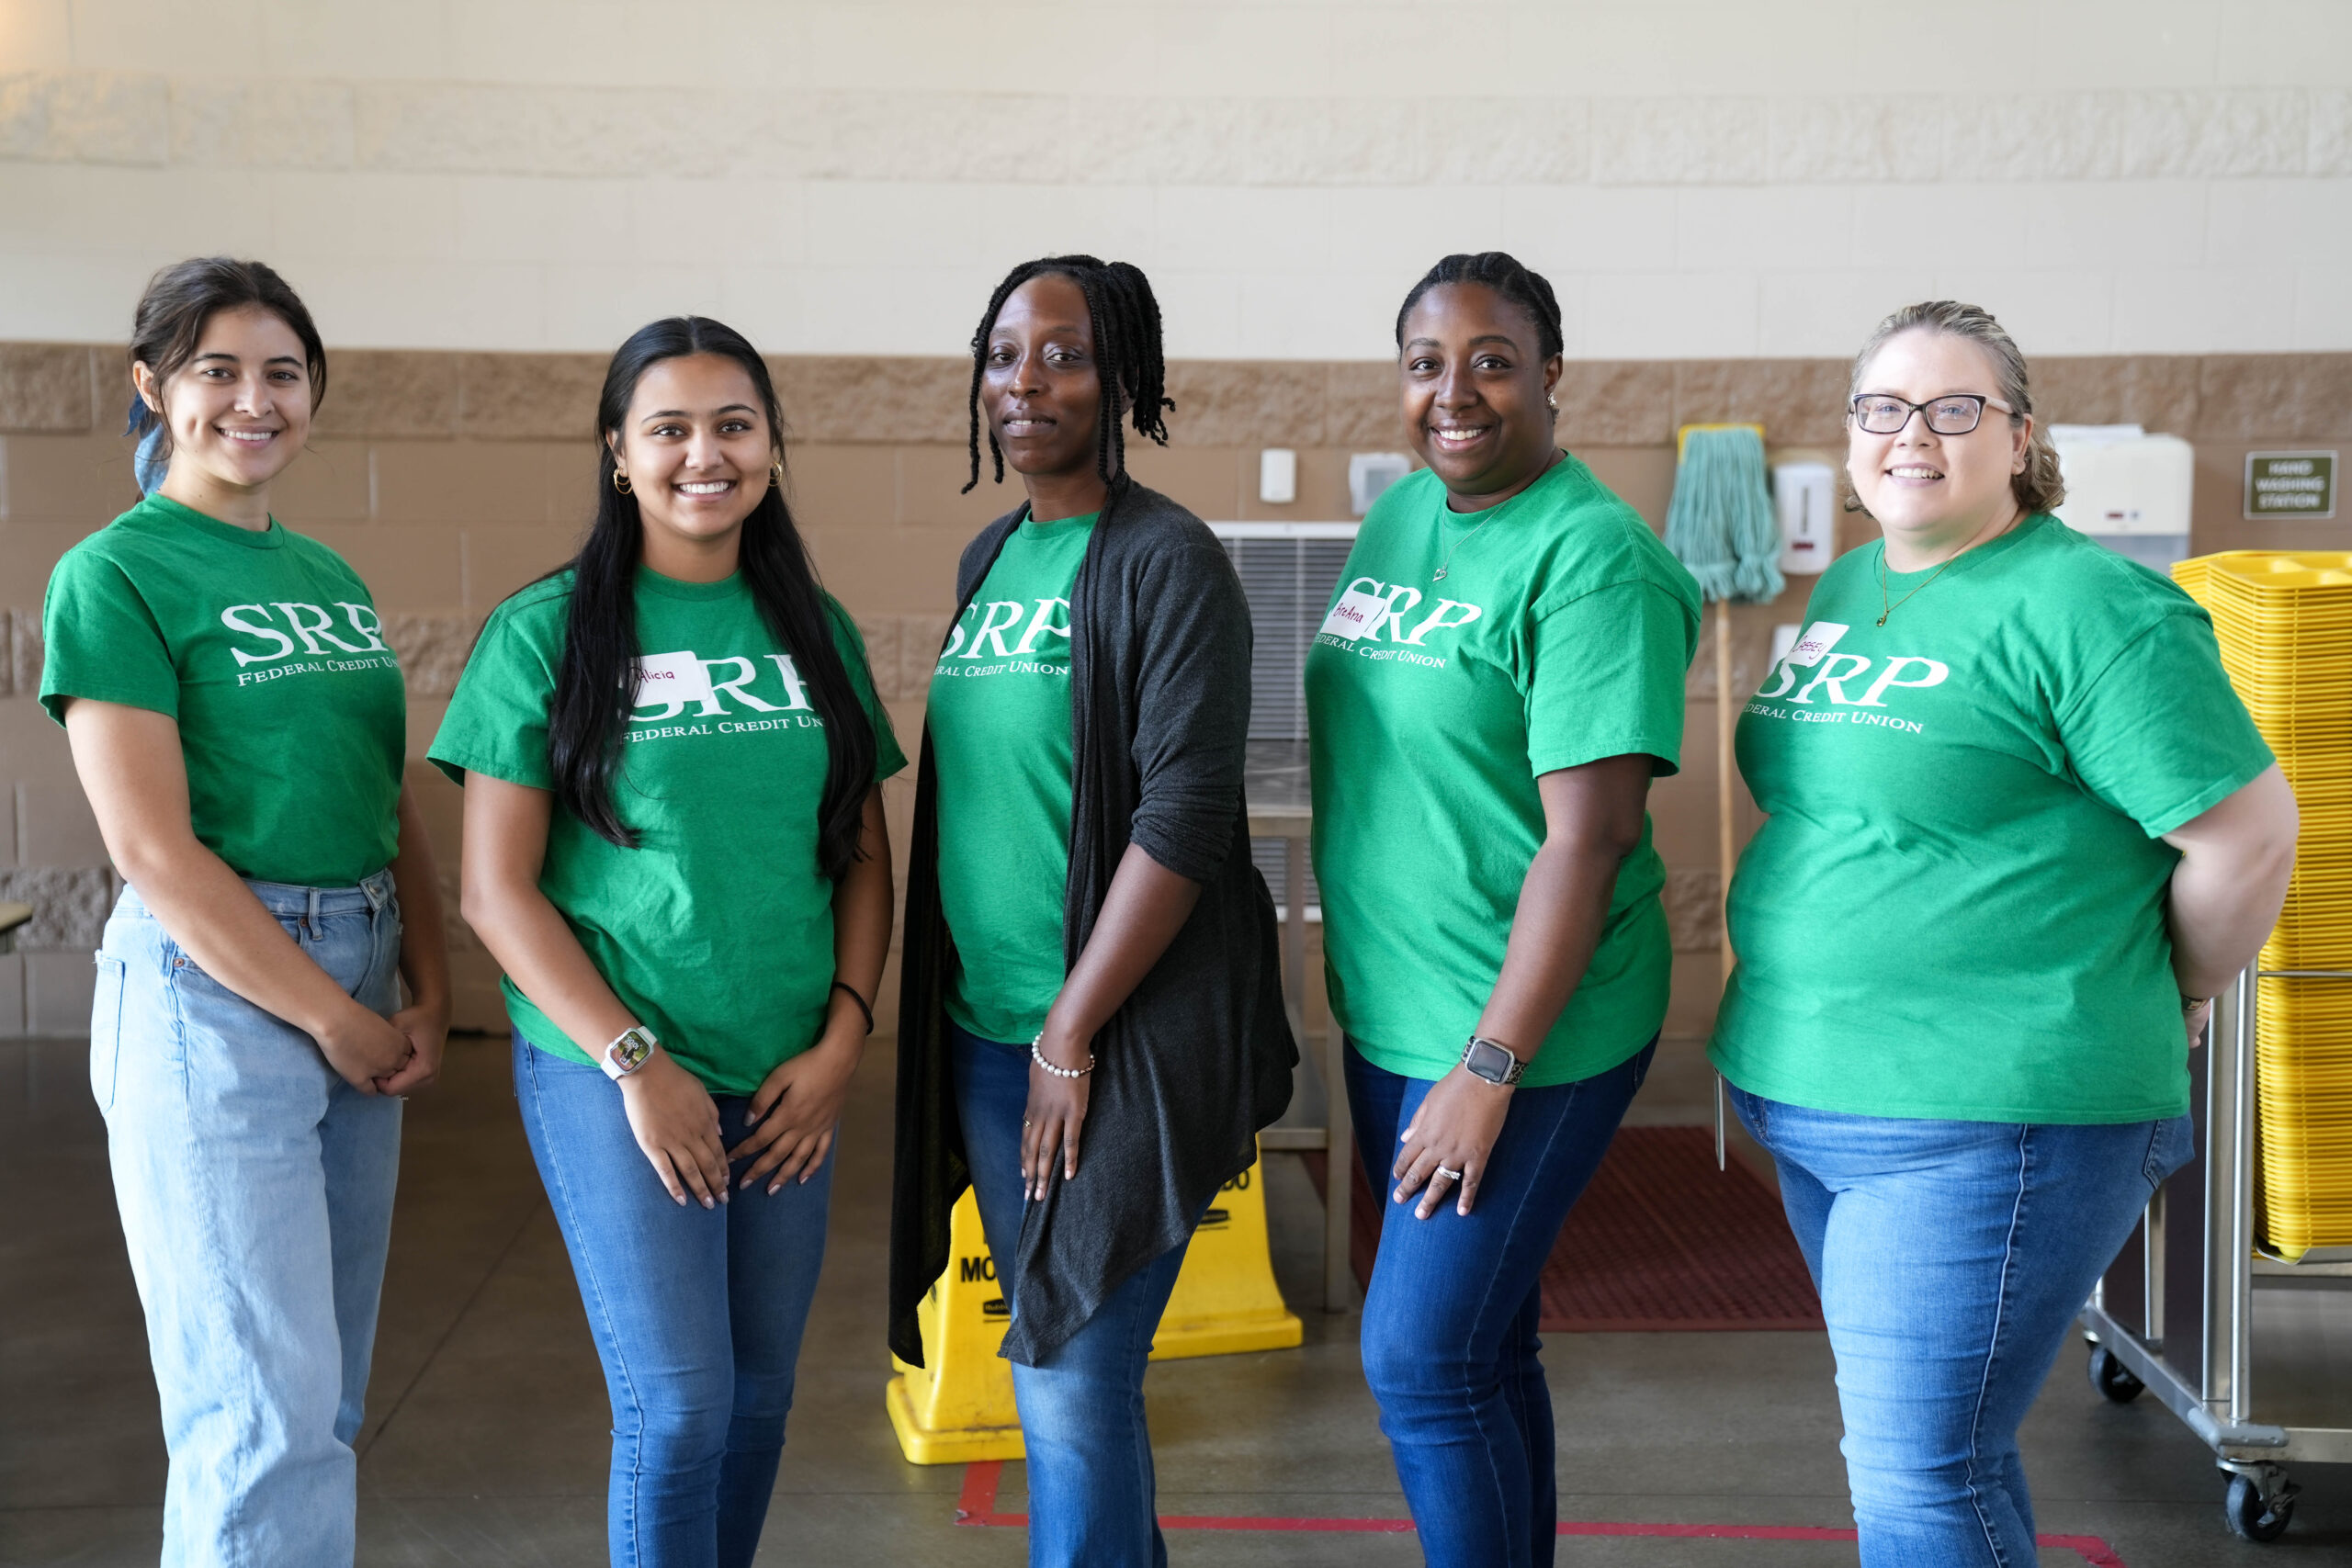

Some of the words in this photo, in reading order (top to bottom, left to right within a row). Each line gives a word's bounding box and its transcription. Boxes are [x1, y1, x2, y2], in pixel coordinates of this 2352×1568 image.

[220, 602, 389, 668] SRP
[965, 664, 1007, 678] CREDIT
[1009, 660, 1069, 675] UNION
[1397, 649, 1448, 669] UNION
[237, 662, 324, 687] FEDERAL
[326, 658, 379, 672] CREDIT
[718, 718, 790, 734] CREDIT
[1792, 709, 1847, 723] CREDIT
[1850, 711, 1924, 734] UNION
